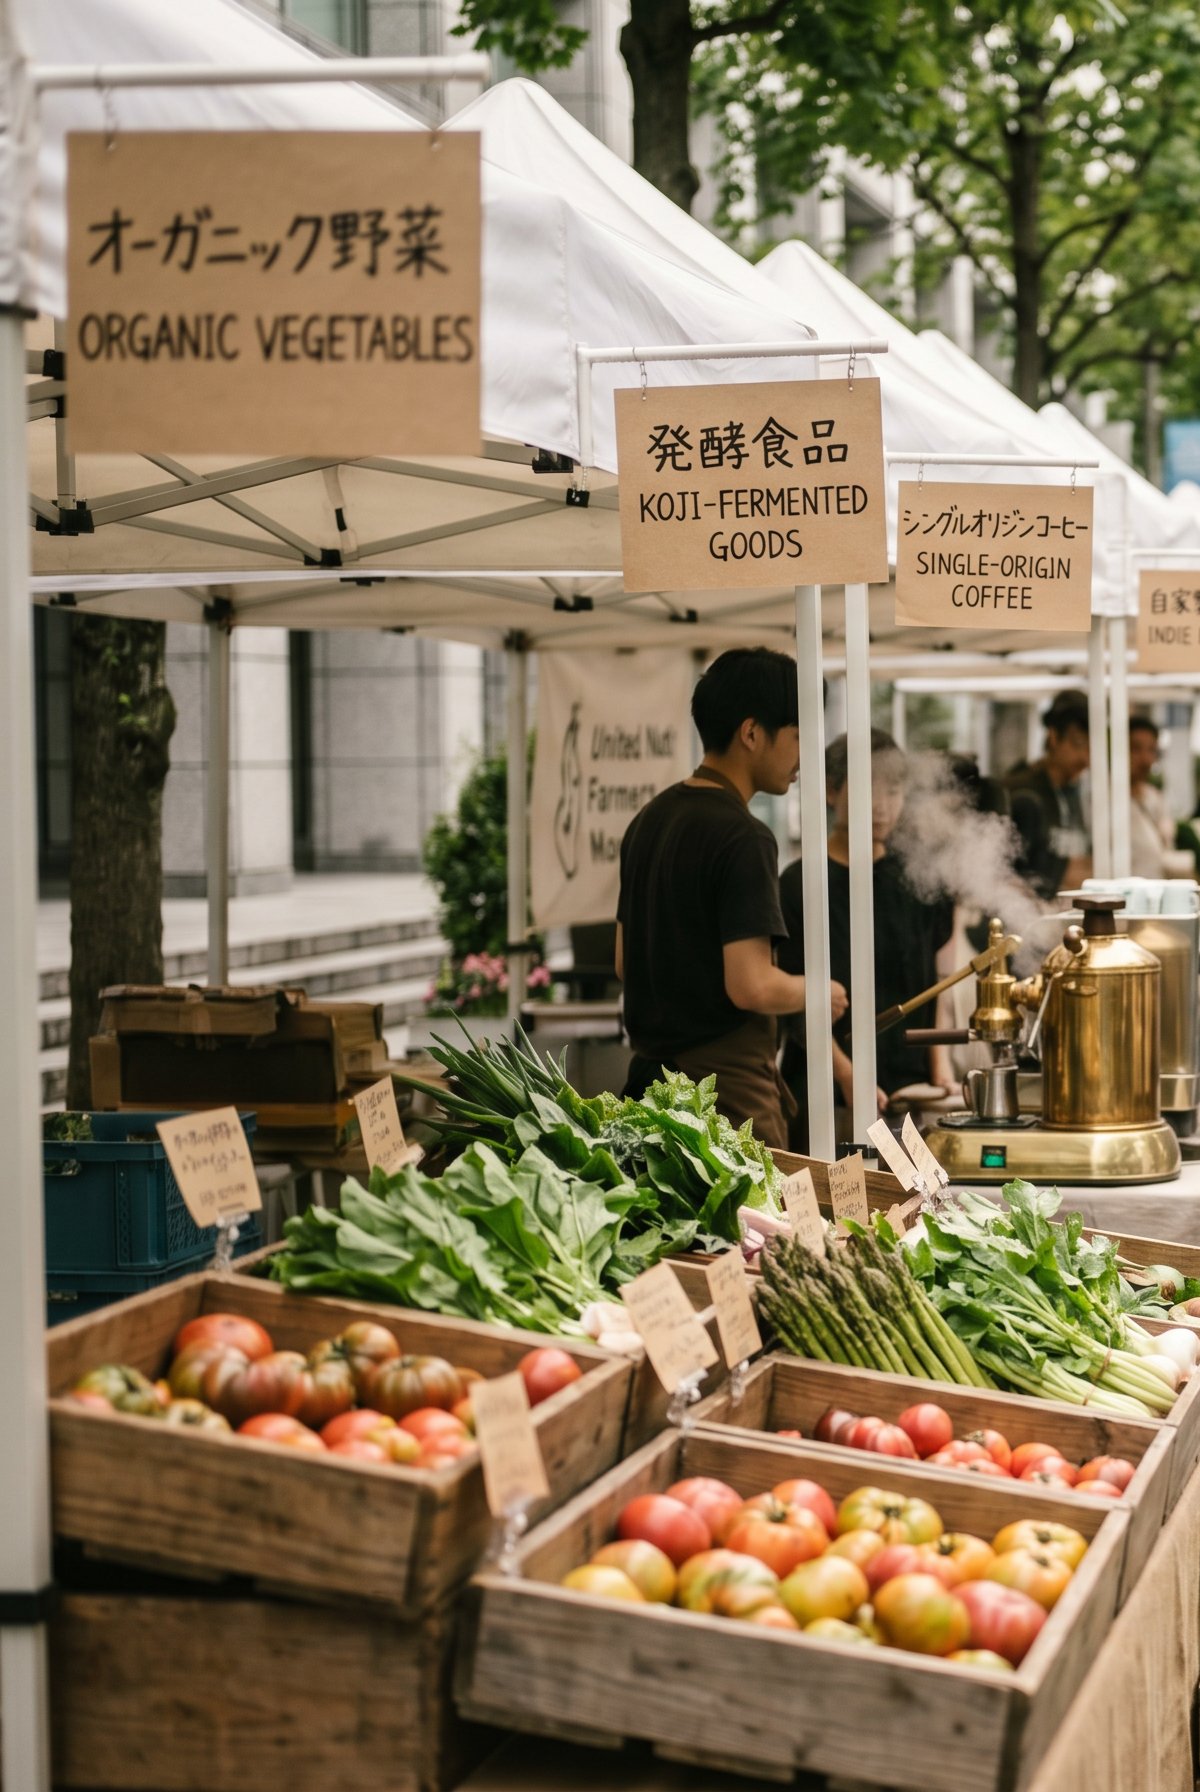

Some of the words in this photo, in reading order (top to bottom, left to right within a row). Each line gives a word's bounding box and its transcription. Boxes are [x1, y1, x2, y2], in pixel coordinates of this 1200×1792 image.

[87, 203, 450, 278] オーガニック野菜
[77, 312, 239, 362] ORGANIC
[254, 313, 474, 363] VEGETABLES
[647, 416, 849, 473] 発酵食品
[639, 484, 868, 523] KOJI-FERMENTED
[903, 505, 1089, 540] シングルオリジンコーヒー
[709, 529, 803, 562] GOODS
[916, 551, 1071, 580] SINGLE-ORIGIN
[951, 583, 1033, 610] COFFEE
[1148, 626, 1191, 646] INDIE
[591, 724, 642, 761] United
